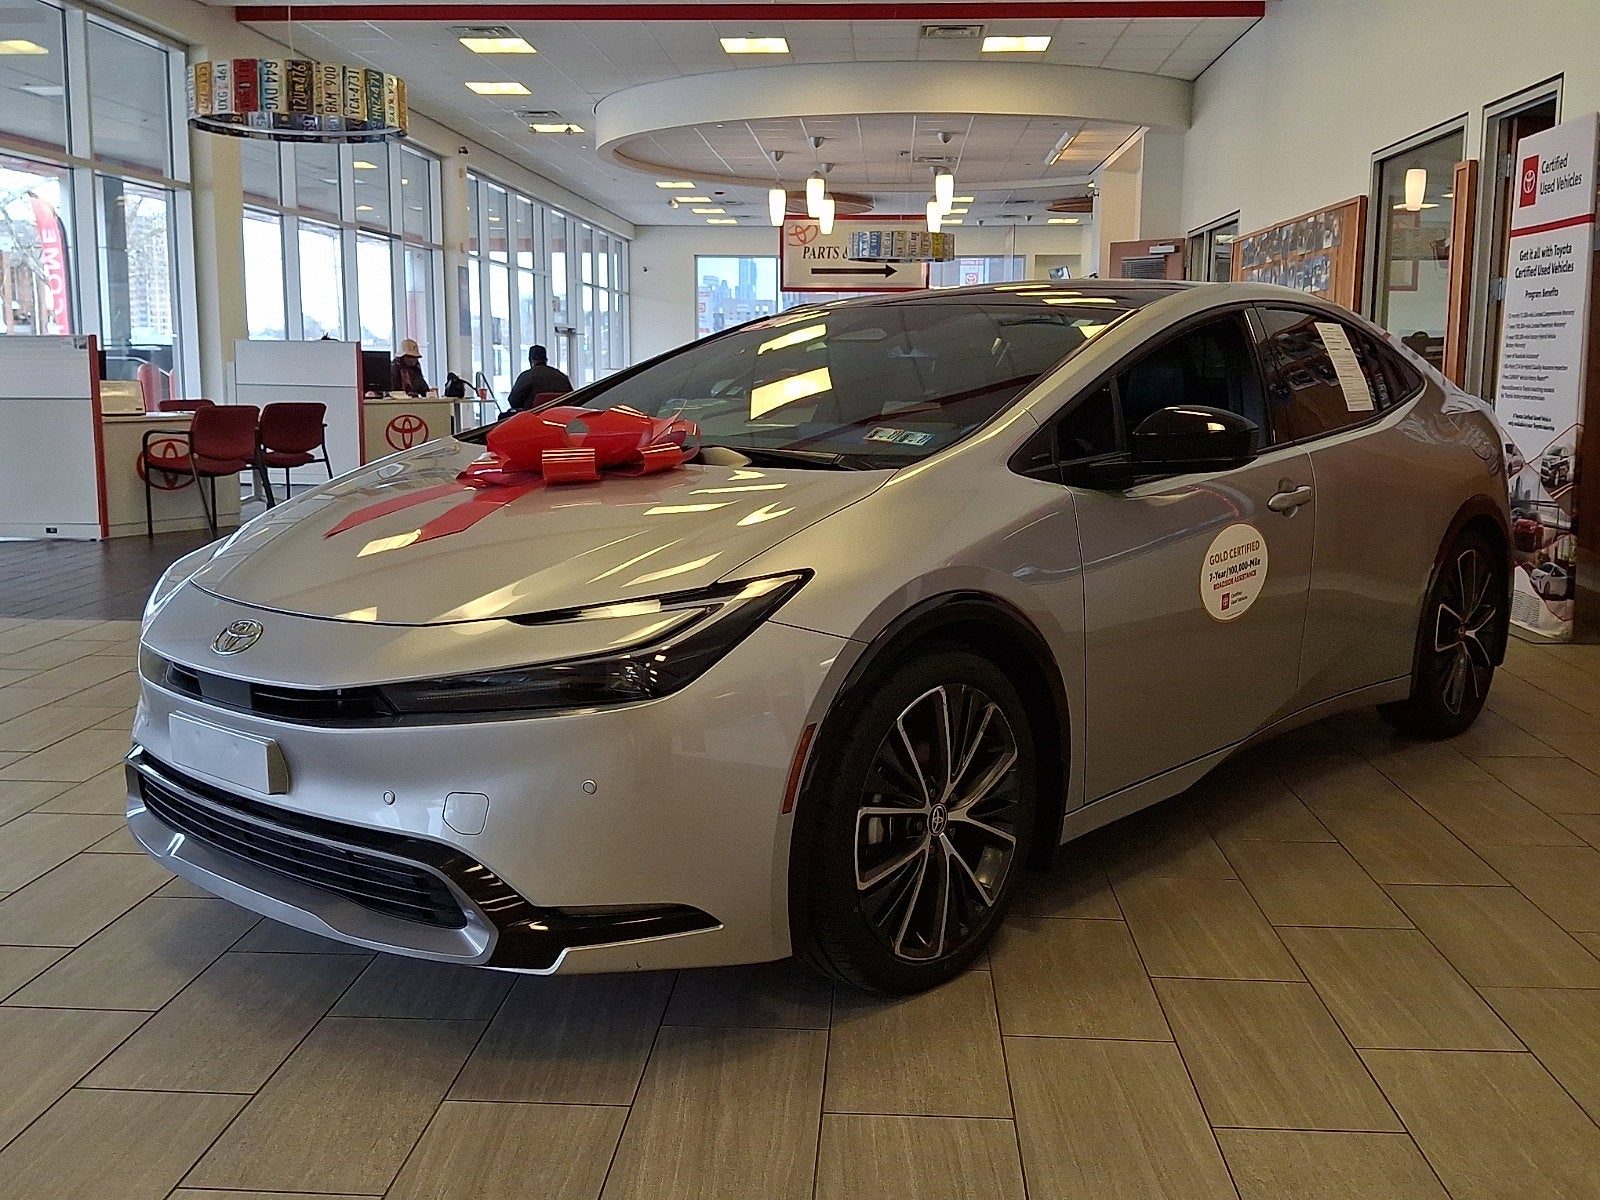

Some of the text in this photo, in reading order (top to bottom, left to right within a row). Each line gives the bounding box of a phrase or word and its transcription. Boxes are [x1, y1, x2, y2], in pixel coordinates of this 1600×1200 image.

[263, 61, 279, 83] 644
[324, 66, 337, 86] 900
[216, 63, 228, 111] UXG 461
[324, 92, 338, 113] BKM
[1541, 152, 1569, 175] Certified
[1540, 171, 1583, 196] Used Vehicles
[802, 245, 840, 260] PARTS
[1520, 250, 1529, 262] Get
[1542, 245, 1553, 258] with
[1554, 242, 1573, 259] Toyota
[1515, 259, 1575, 279] Certified Used Vehicles
[1209, 540, 1260, 566] GOLD CERTIFIED
